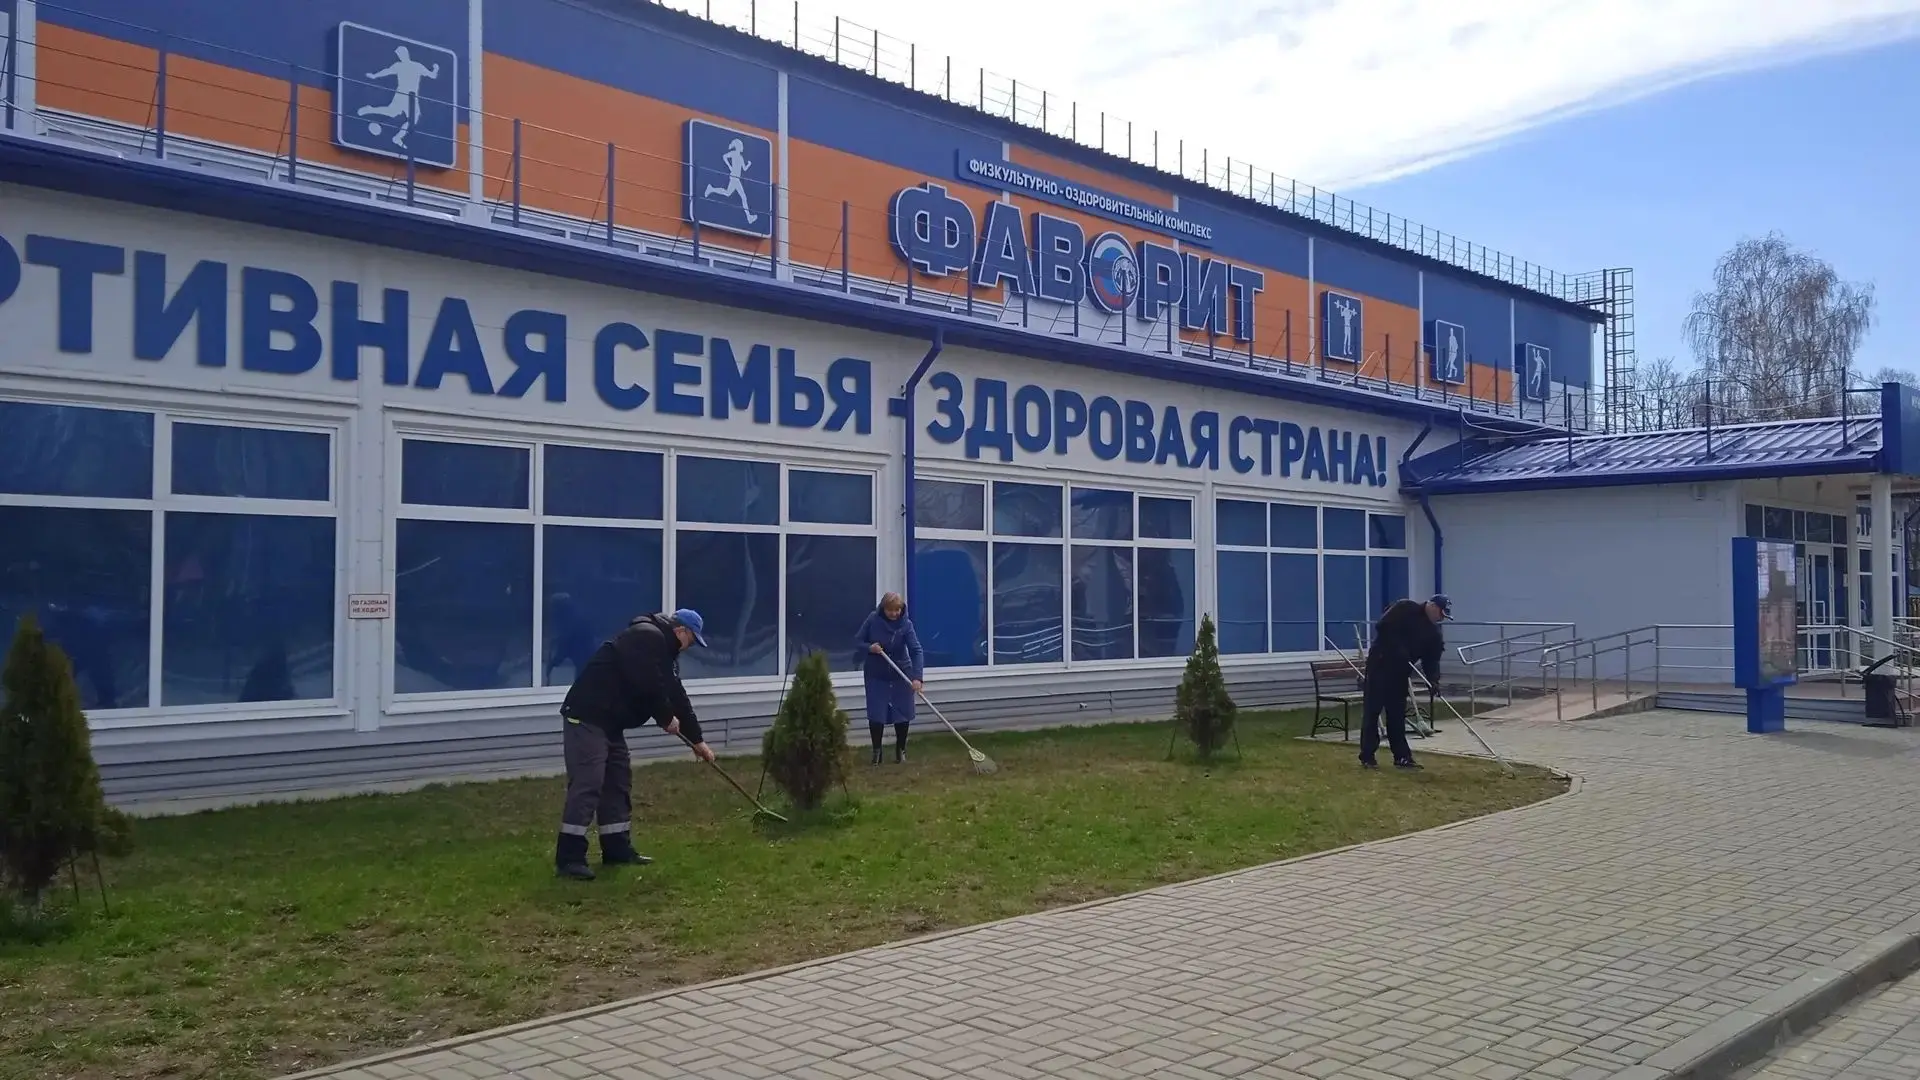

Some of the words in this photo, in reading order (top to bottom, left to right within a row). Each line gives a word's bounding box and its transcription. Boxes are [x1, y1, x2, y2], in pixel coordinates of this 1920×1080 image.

[890, 182, 1264, 341] ФАВОРИТ
[969, 158, 1058, 195] ФИЗКУЛЬТУРНО
[1065, 186, 1164, 228] ОЗДОРОВИТЕЛЬНЫЙ
[1165, 215, 1212, 239] КОМПЛЕКС
[0, 233, 567, 403] ТИВНАЯ
[594, 321, 872, 435] СЕМЬЯ
[926, 371, 1219, 469] ЗДОРОВАЯ
[1229, 415, 1387, 488] СТРАНА!
